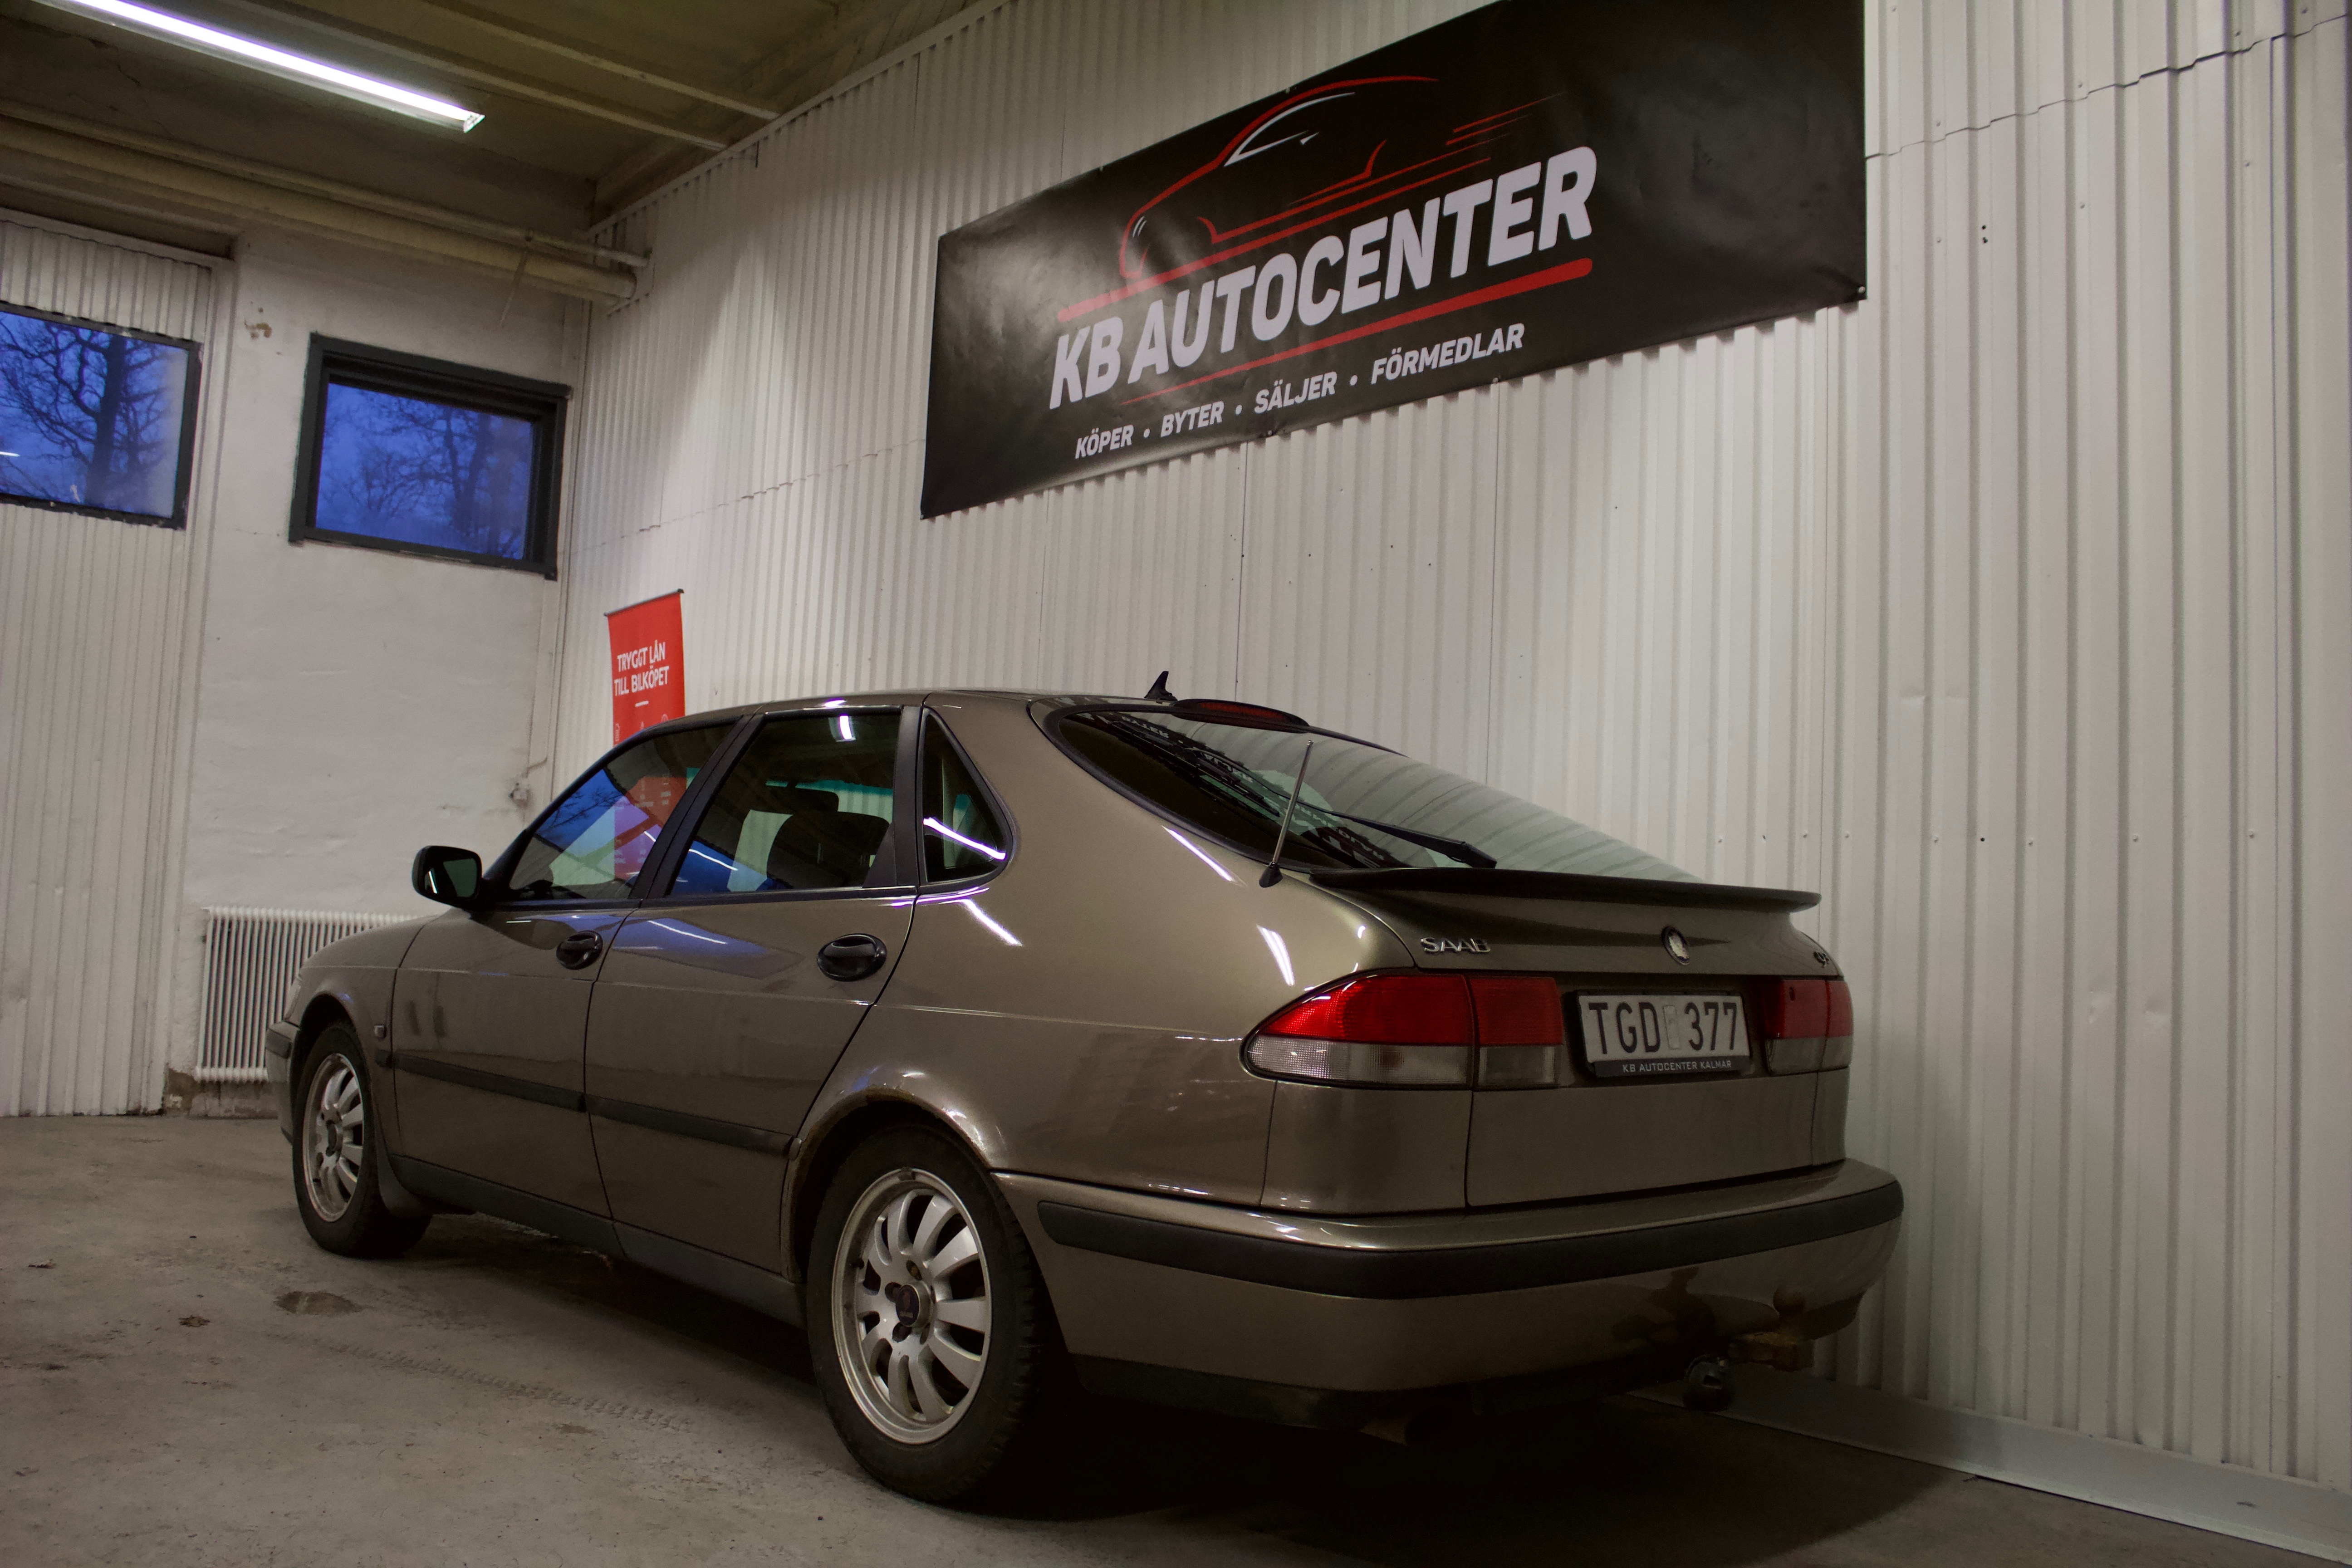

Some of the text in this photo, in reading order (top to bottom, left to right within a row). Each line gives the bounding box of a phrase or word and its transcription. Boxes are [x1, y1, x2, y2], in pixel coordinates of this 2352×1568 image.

[1050, 146, 1597, 409] KB AUTOCENTER
[1075, 323, 1525, 459] KÖPER BYTER SÄLJER FÖRMEDLAR
[617, 639, 666, 672] TRYGGT LÅN
[613, 665, 670, 696] TILL BILKÖPET
[1420, 937, 1491, 952] SAAB
[1589, 1002, 1738, 1055] TGD 377
[1622, 1059, 1732, 1073] KB AUTOCENTER KALMAR
